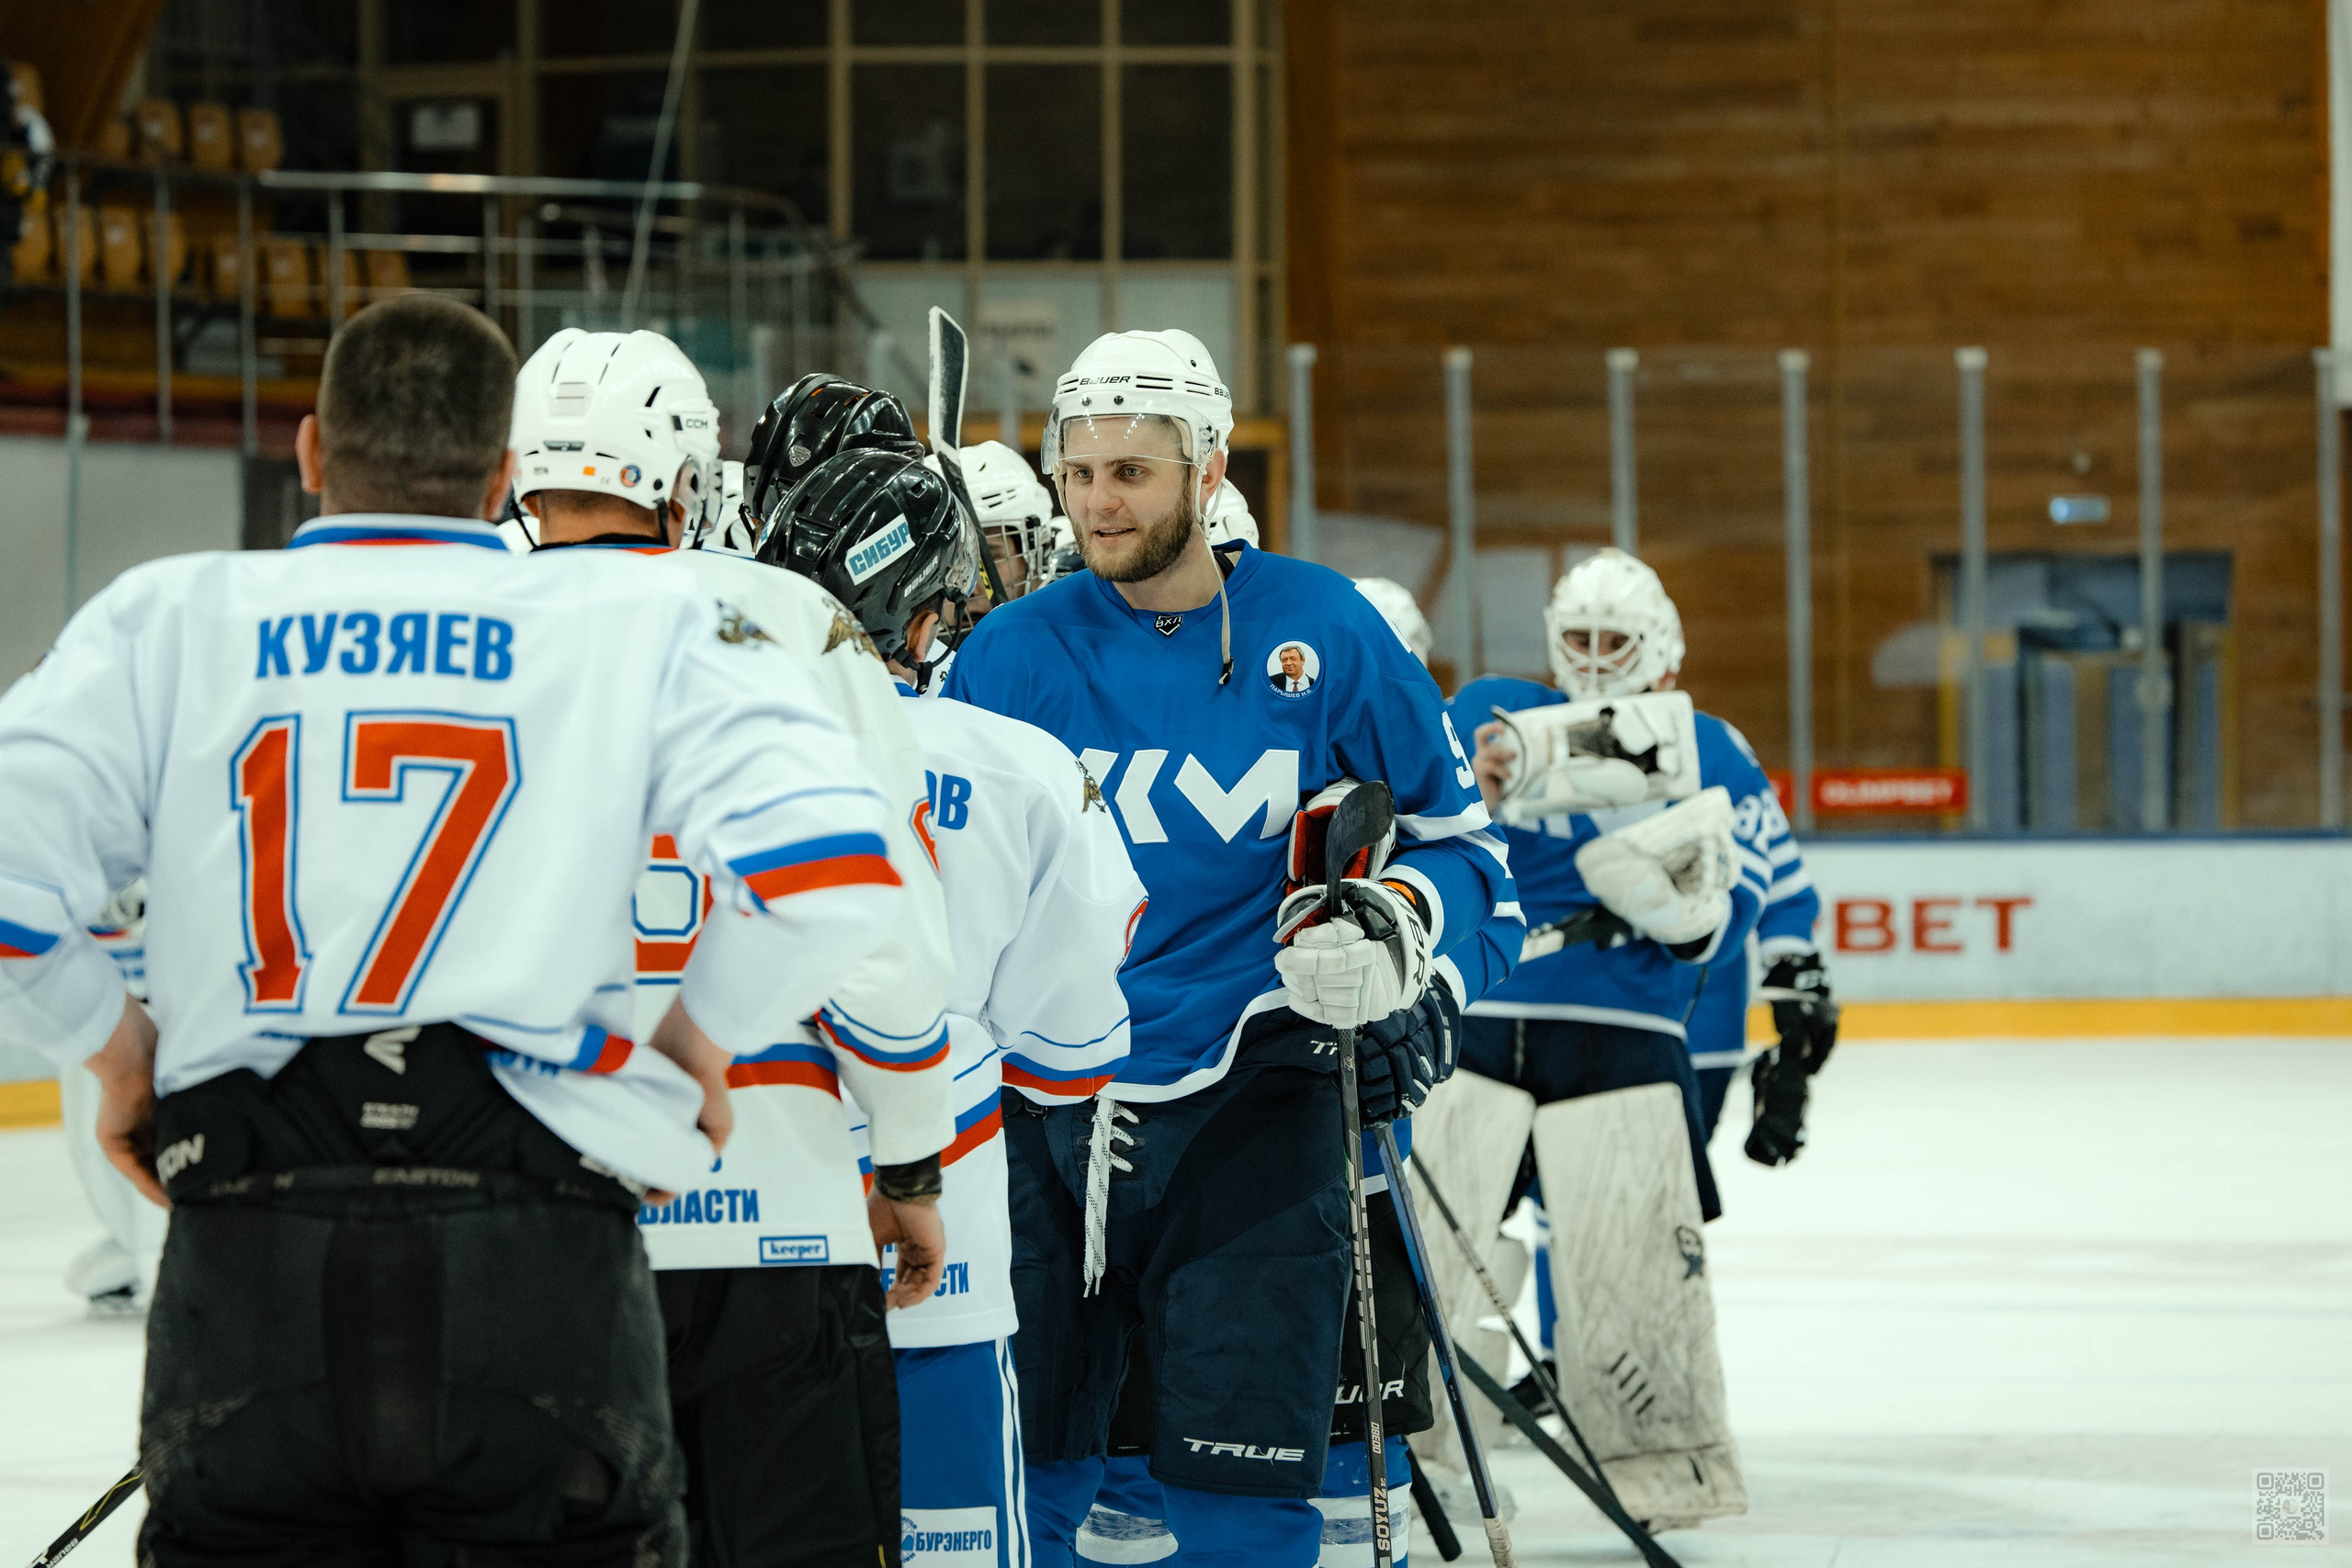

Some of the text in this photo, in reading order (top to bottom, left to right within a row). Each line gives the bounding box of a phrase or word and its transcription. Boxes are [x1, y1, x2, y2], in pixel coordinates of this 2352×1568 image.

[848, 521, 910, 577] СИБУР
[255, 610, 514, 682] КУЗЯЕВ
[1268, 683, 1302, 699] ПАРЫШЕВ
[229, 708, 523, 1017] 17
[1814, 897, 2034, 953] BET
[770, 1240, 822, 1259] keeper
[1182, 1437, 1306, 1463] TRUE
[915, 1529, 992, 1552] БУРЭНЕРГО
[1373, 1486, 1391, 1552] SOYUZ
